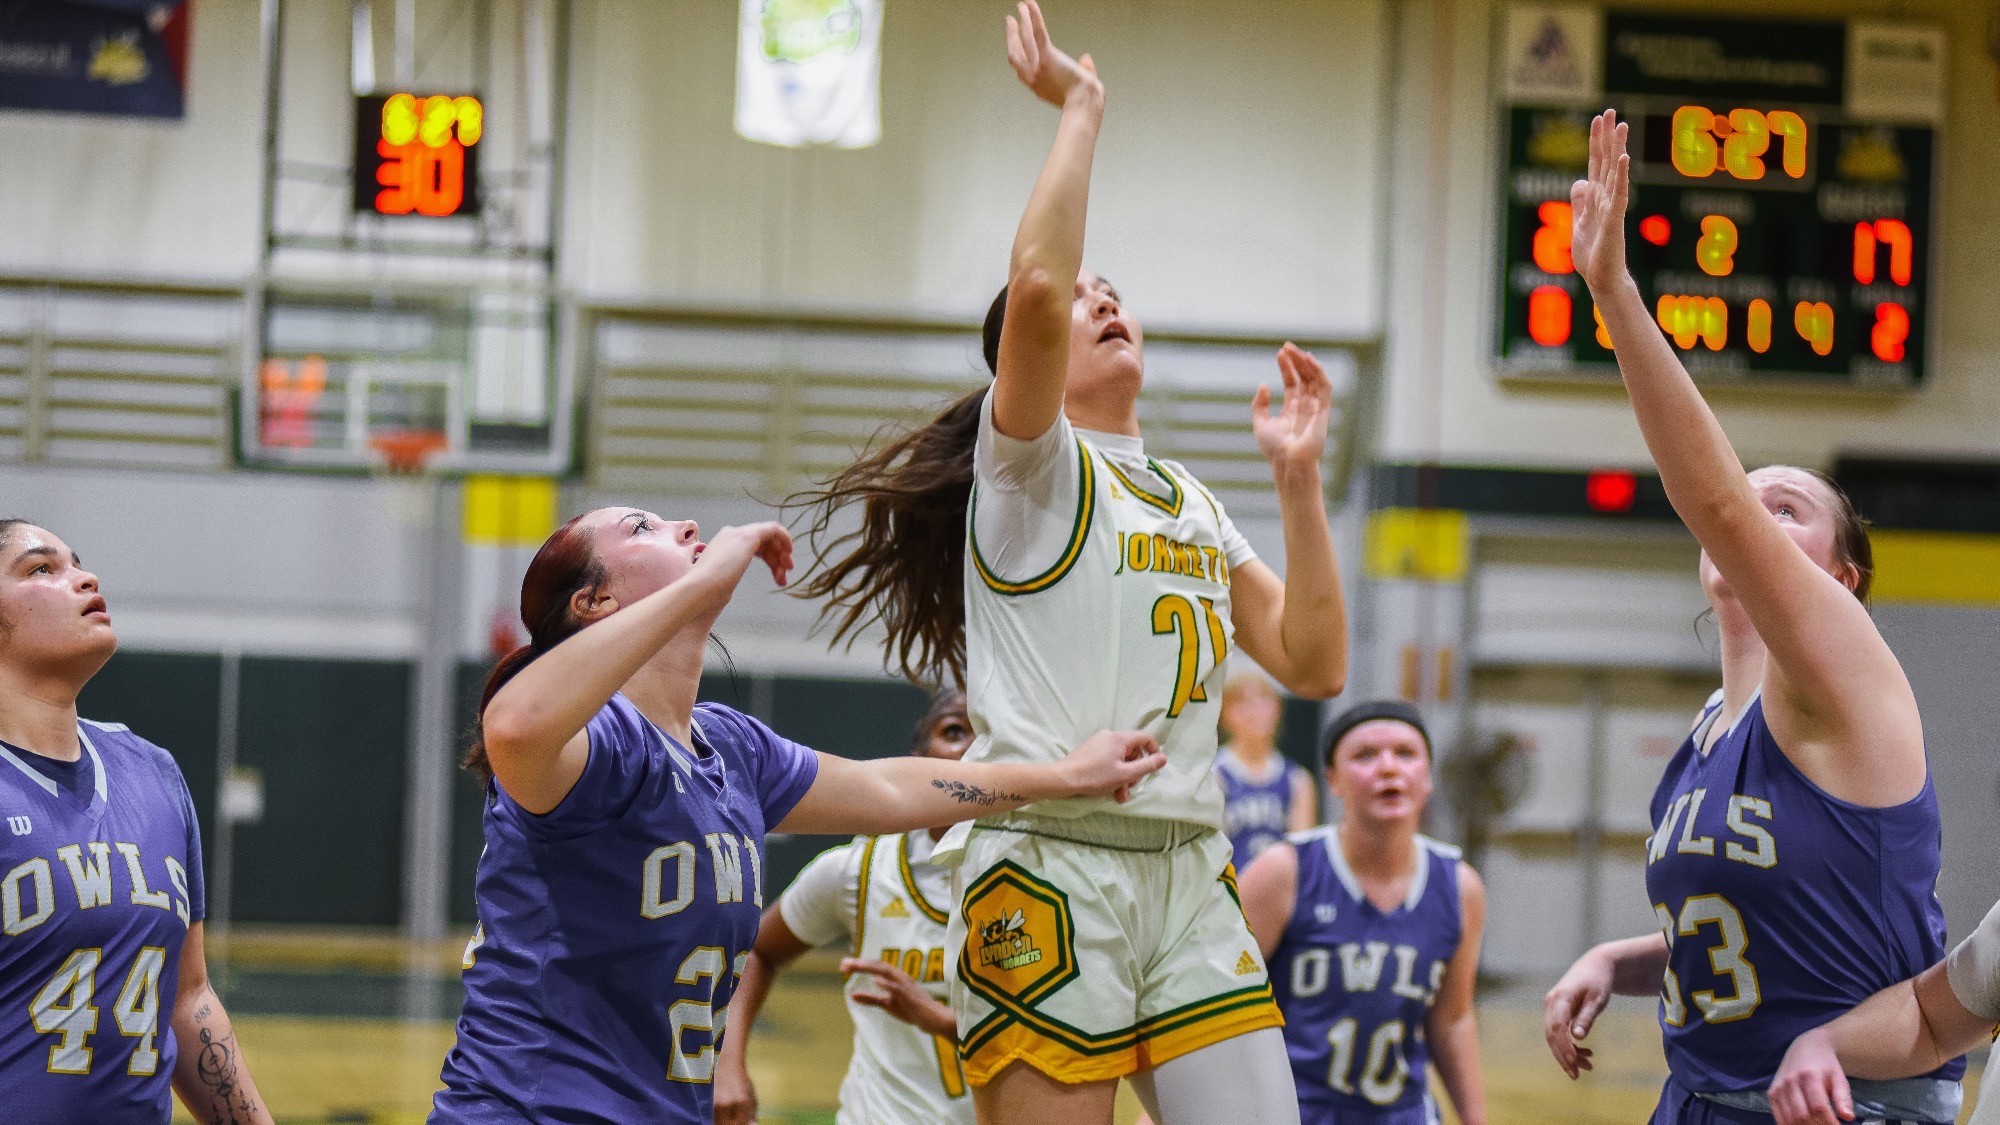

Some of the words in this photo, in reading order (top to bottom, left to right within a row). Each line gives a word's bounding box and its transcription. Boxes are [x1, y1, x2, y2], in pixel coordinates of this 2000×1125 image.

[375, 137, 464, 216] 30
[1672, 105, 1807, 180] 6:27
[1533, 201, 1577, 274] 2
[1697, 215, 1738, 276] 2
[1853, 218, 1913, 286] 17
[1529, 285, 1571, 346] 0
[1747, 299, 1772, 353] 1
[1795, 301, 1834, 356] 4
[1871, 302, 1910, 362] 2
[1152, 594, 1226, 718] 21
[1646, 788, 1778, 869] WLS
[1, 841, 190, 936] OWLS
[28, 947, 165, 1077] 44
